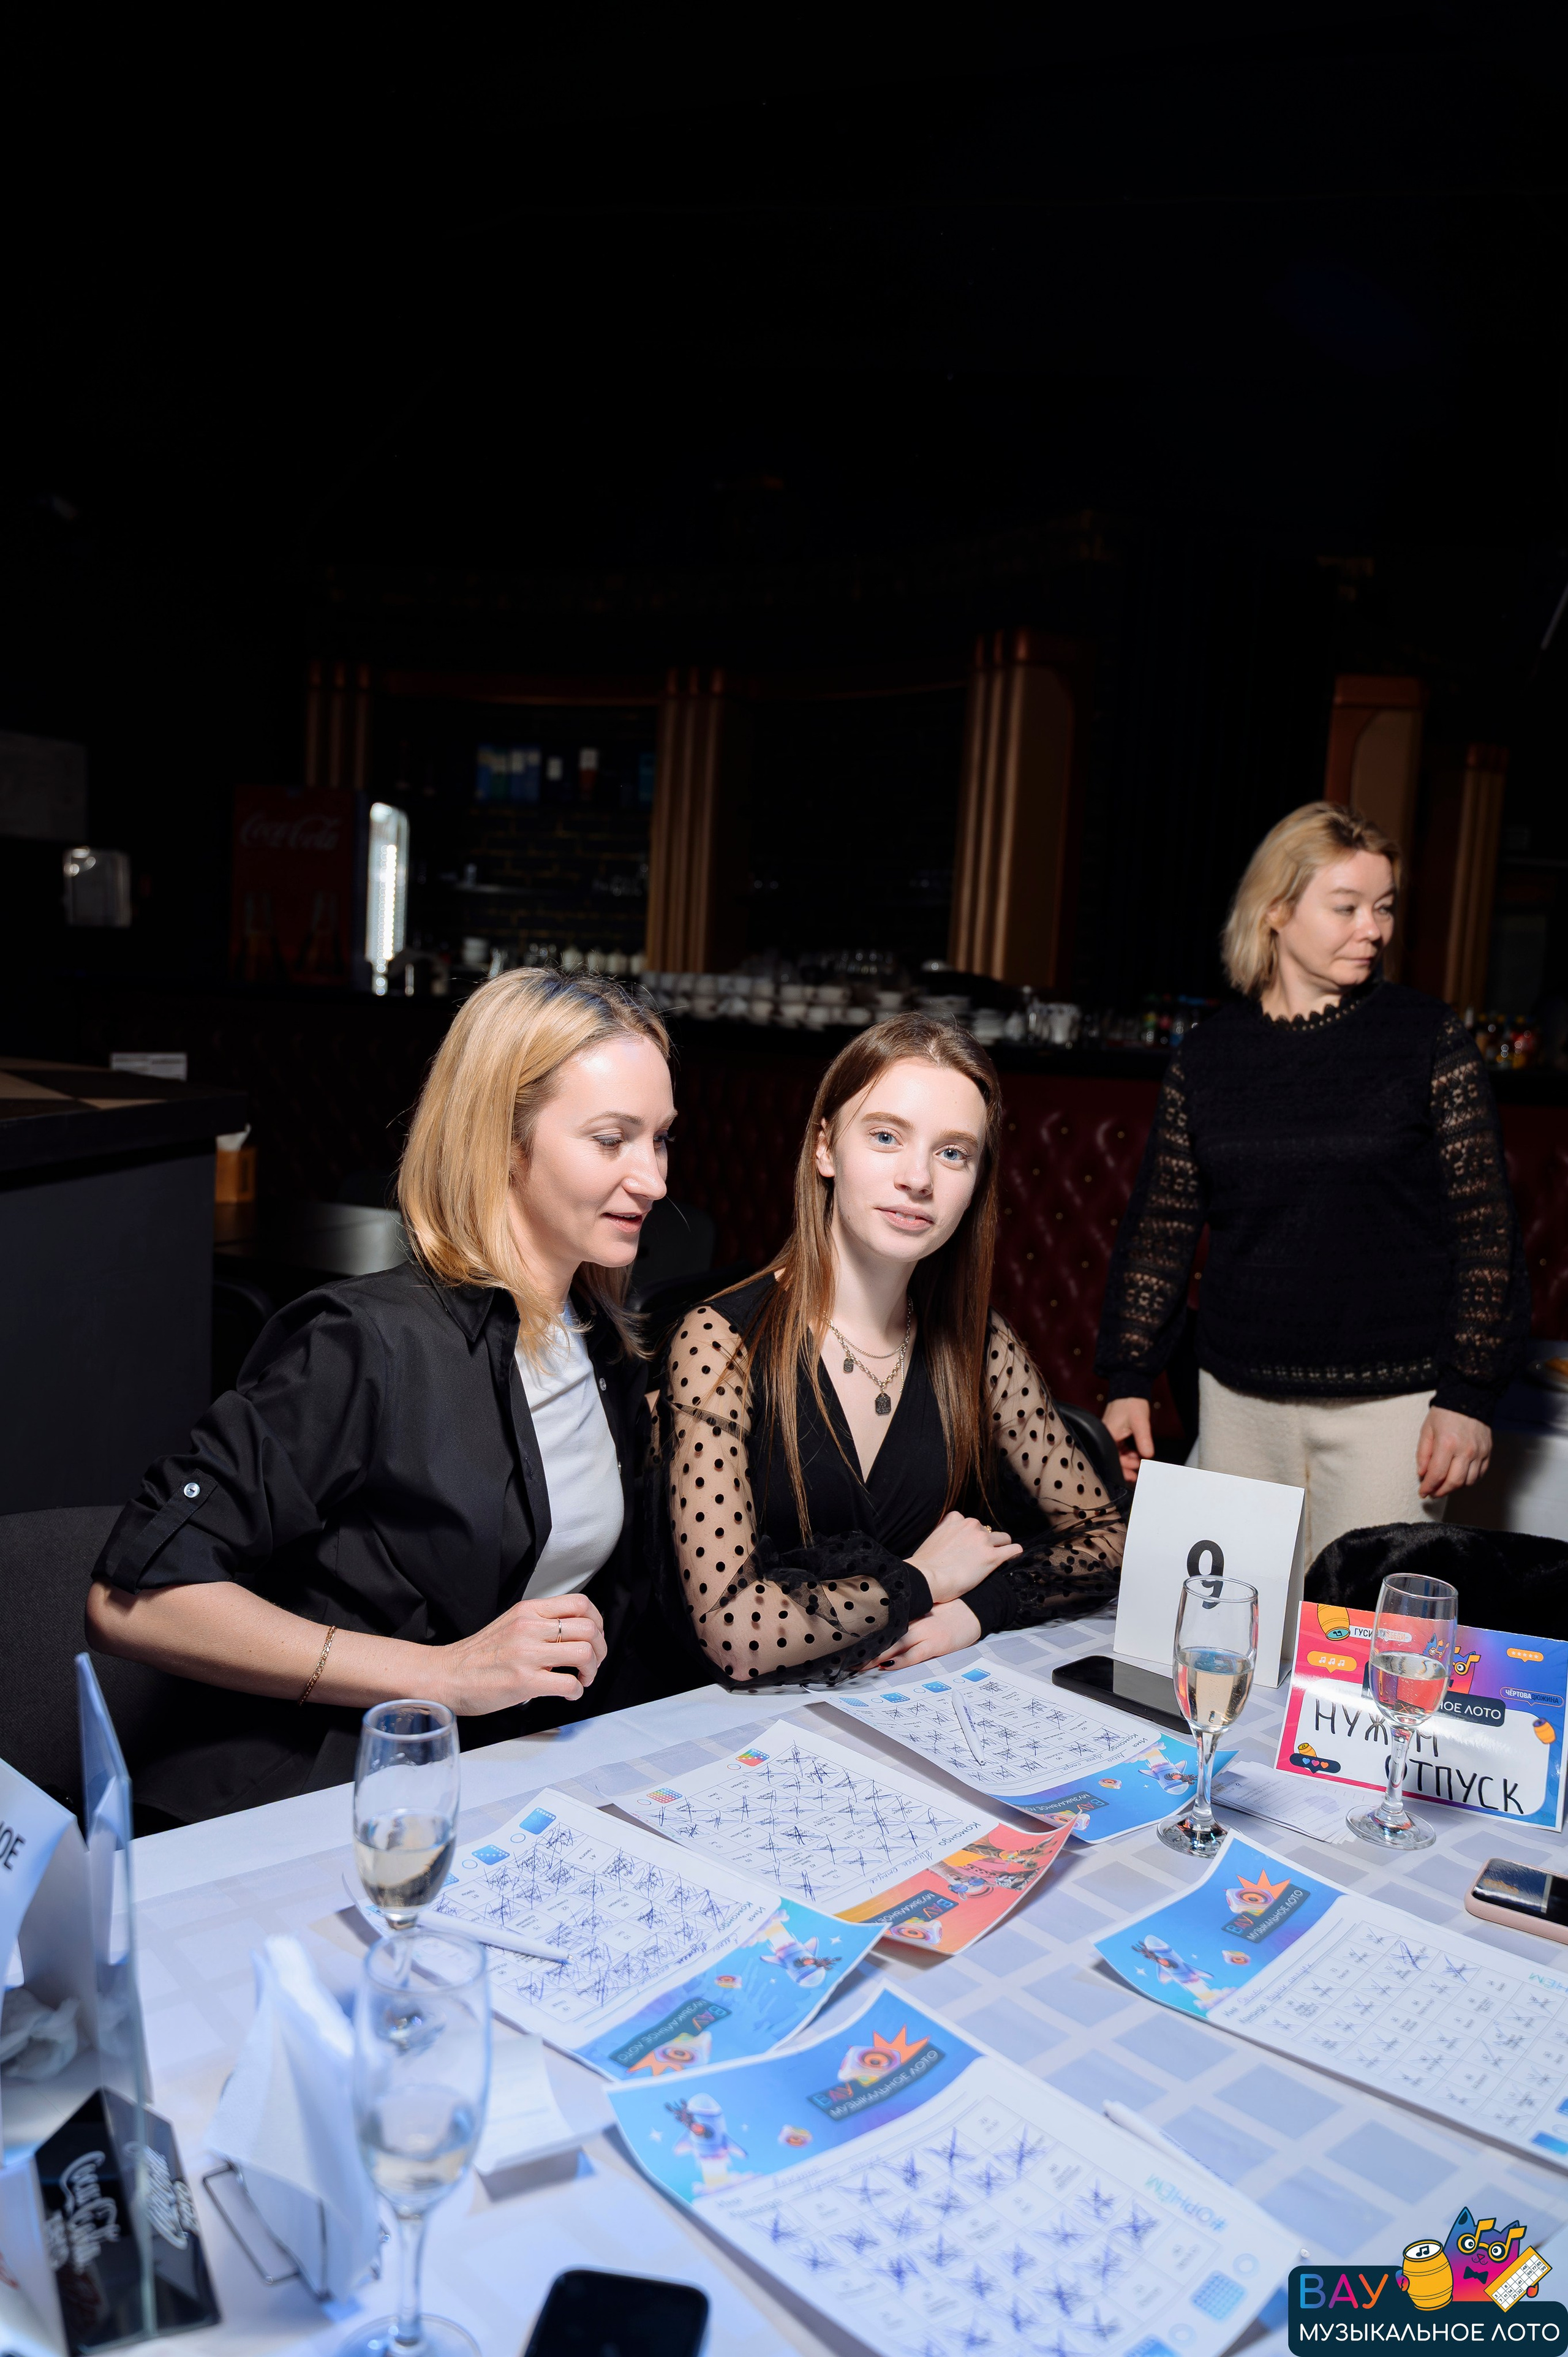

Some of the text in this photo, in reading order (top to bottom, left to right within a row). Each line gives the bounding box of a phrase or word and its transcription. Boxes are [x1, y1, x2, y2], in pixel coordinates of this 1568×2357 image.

[1187, 1540, 1224, 1609] 9
[1464, 1705, 1501, 1719] ЛОТО
[1315, 1699, 1439, 1757] НУЖН
[1109, 1733, 1139, 1752] Команда
[1133, 1738, 1148, 1748] Имя
[1385, 1755, 1525, 1815] ОТПУСК
[1036, 1793, 1090, 1811] МУЗЫКАЛЬНОЕ
[1077, 1798, 1105, 1811] ВАУ
[938, 1822, 981, 1846] Команда
[718, 1901, 753, 1931] Команда
[747, 1906, 766, 1921] Имя
[878, 1893, 935, 1924] МУЗЫКАЛЬНОЕ
[922, 1898, 954, 1918] ВАУ
[1246, 1890, 1304, 1940] МУЗЫКАЛЬНОЕ ЛОТО
[1226, 1915, 1254, 1934] ВАУ
[692, 2005, 727, 2031] ВАУ
[1222, 2006, 1239, 2017] Имя
[1237, 2004, 1267, 2024] Команда
[618, 1999, 706, 2061] МУЗЫКАЛЬНОЕ ЛОТО
[812, 2082, 854, 2108] ВАУ
[829, 2050, 938, 2118] МУЗЫКАЛЬНОЕ ЛОТО
